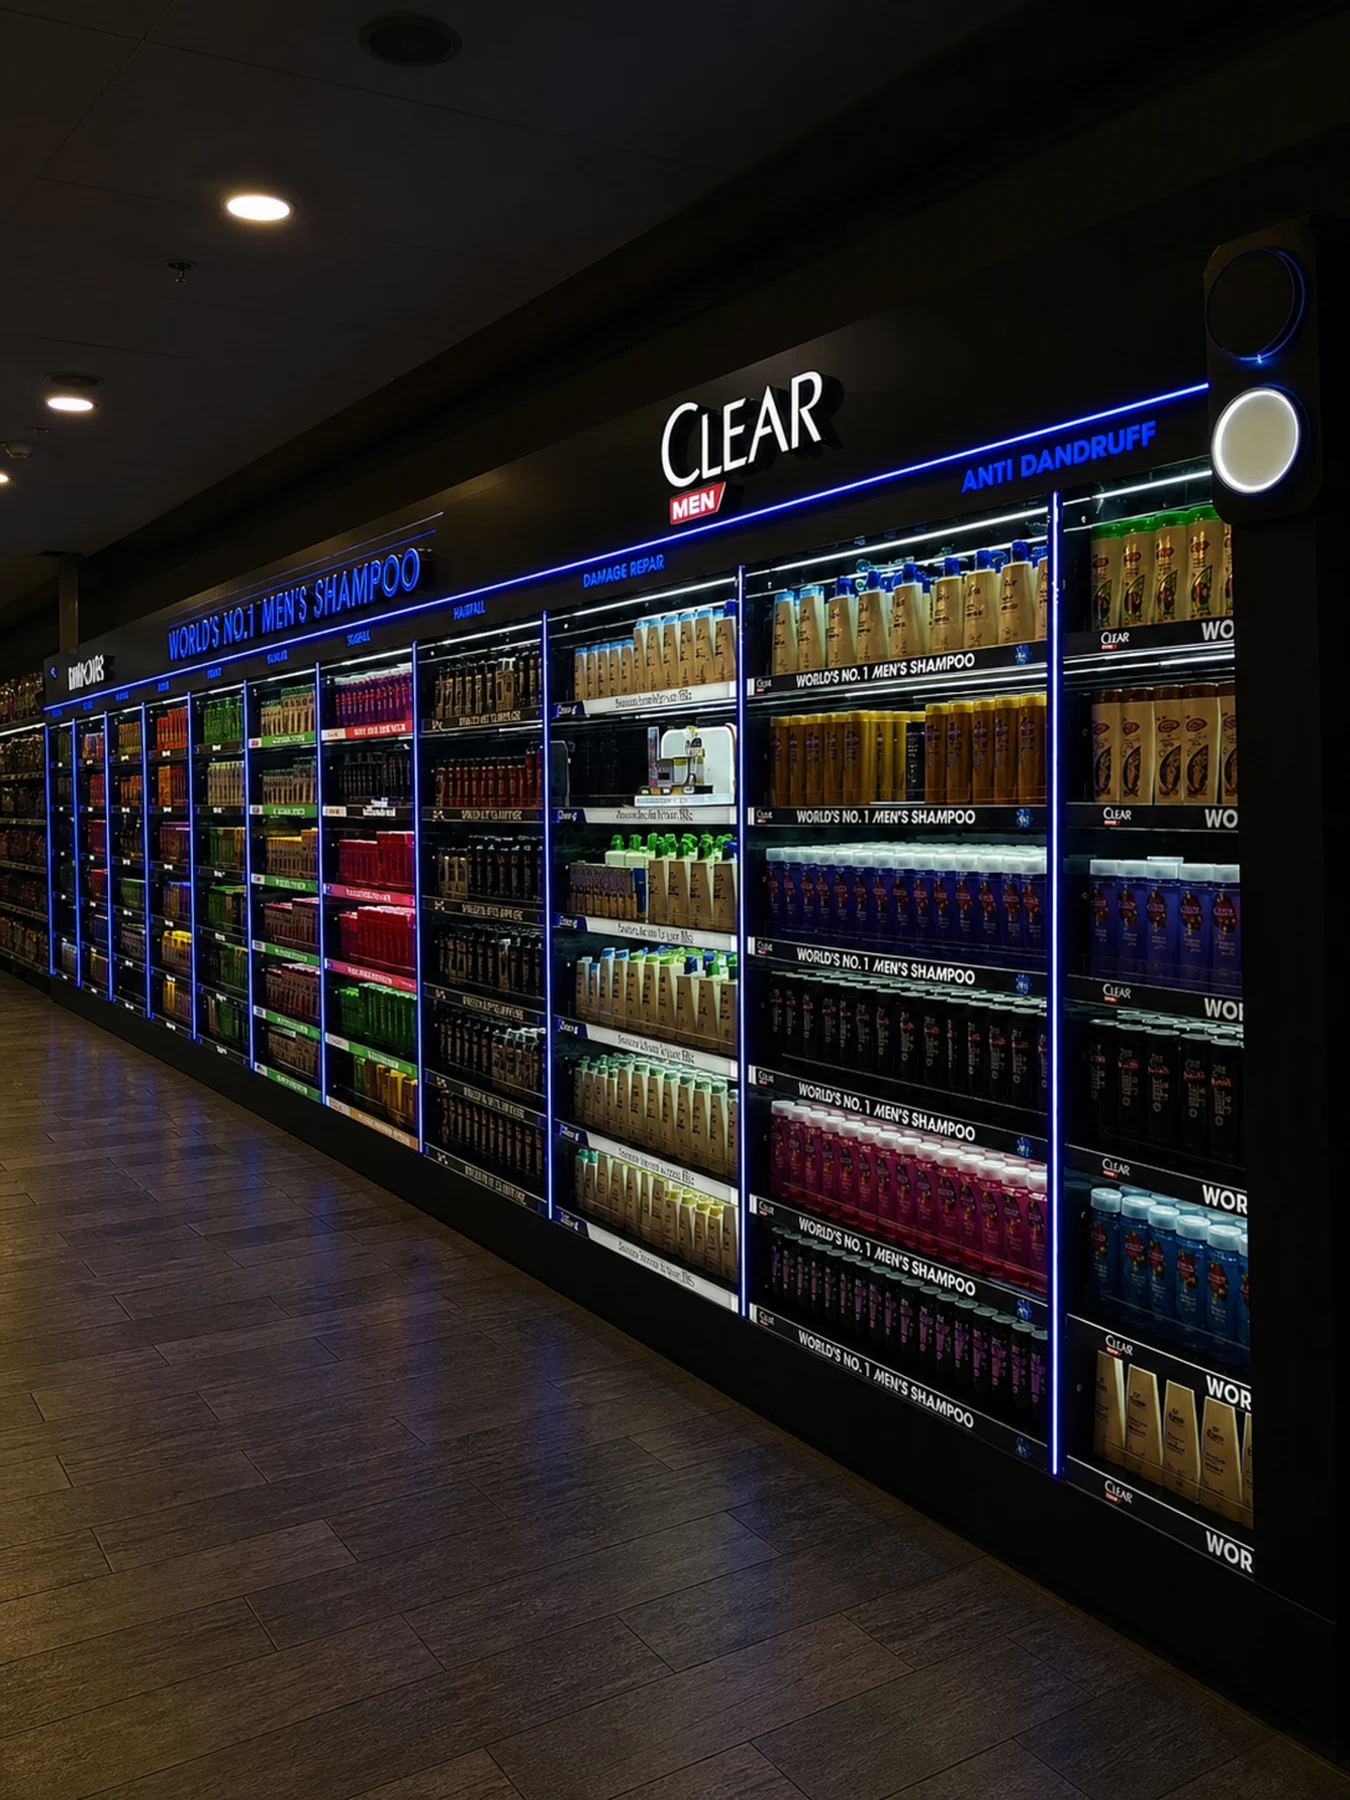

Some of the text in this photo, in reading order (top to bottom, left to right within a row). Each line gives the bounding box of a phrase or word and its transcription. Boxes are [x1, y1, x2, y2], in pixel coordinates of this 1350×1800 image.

[661, 370, 823, 487] CLEAR
[961, 421, 1157, 492] ANTI DANDRUFF
[672, 490, 716, 521] MEN
[583, 554, 665, 588] DAMAGE REPAIR
[168, 615, 220, 662] WORLD'S
[261, 586, 308, 633] MEN'S
[313, 547, 421, 618] SHAMPOO
[1100, 631, 1130, 645] CLEAR
[796, 669, 839, 688] WORLD'S
[842, 667, 861, 682] NO.
[872, 662, 907, 679] MEN'S
[910, 653, 975, 674] SHAMPOO
[797, 810, 839, 824] WORLD'S
[842, 810, 861, 824] NO.
[872, 810, 908, 824] MEN'S
[911, 810, 975, 824] SHAMPOO
[1103, 806, 1132, 820] CLEAR
[1205, 809, 1238, 828] WO
[797, 948, 840, 967] WORLD'S
[842, 955, 861, 970] NO.
[873, 959, 908, 976] MEN'S
[911, 963, 975, 984] SHAMPOO
[1103, 983, 1132, 999] CLEAR
[799, 1082, 841, 1106] WORLD'S
[843, 1095, 862, 1111] NO.
[874, 1104, 909, 1125] MEN'S
[912, 1113, 975, 1142] SHAMPOO
[1102, 1158, 1131, 1176] CLEAR
[1202, 1185, 1248, 1215] WOR
[799, 1216, 842, 1245] WORLD'S
[844, 1235, 862, 1253] NO.
[874, 1247, 909, 1271] MEN'S
[912, 1261, 975, 1296] SHAMPOO
[1105, 1335, 1133, 1356] CLEAR
[799, 1330, 841, 1362] WORLD'S
[844, 1353, 862, 1373] NO.
[874, 1369, 909, 1396] MEN'S
[911, 1386, 974, 1429] SHAMPOO
[1205, 1375, 1252, 1411] WOR
[1104, 1480, 1133, 1504] CLEAR
[1206, 1531, 1253, 1573] WOR
